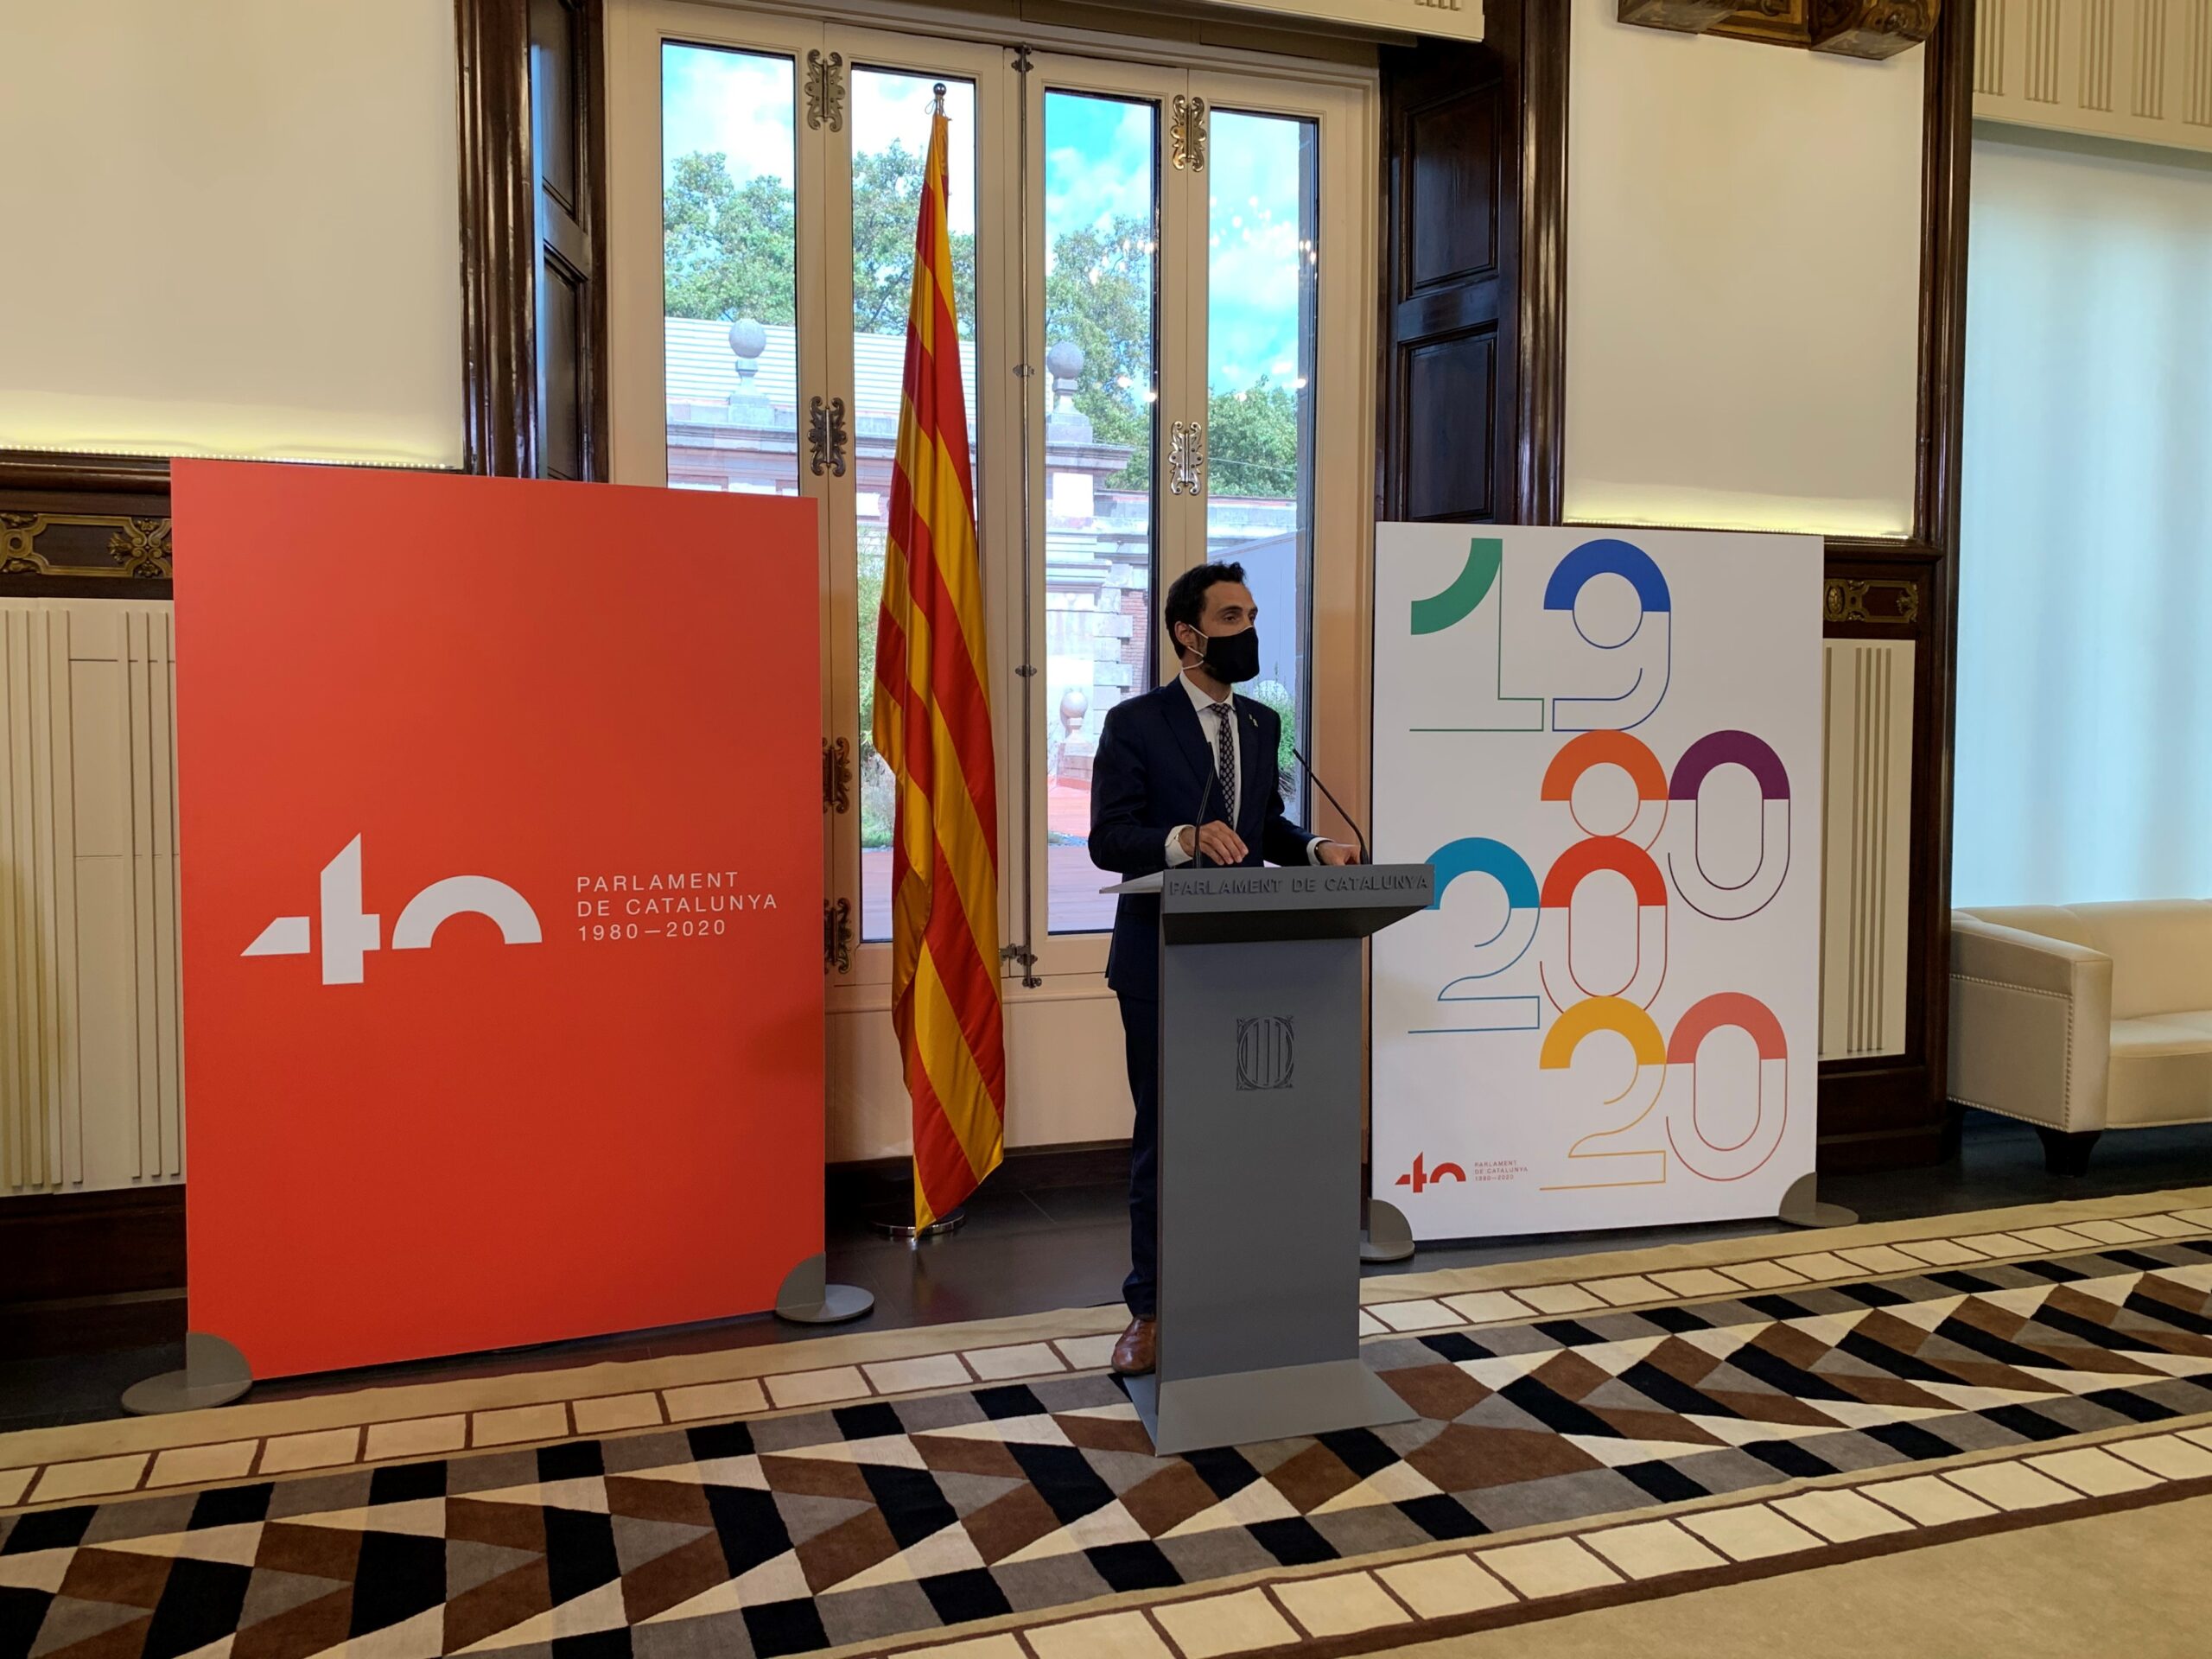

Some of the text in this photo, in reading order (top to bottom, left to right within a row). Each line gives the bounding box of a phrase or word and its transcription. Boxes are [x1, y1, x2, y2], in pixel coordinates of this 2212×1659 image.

[577, 871, 738, 893] PARLAMENT
[1169, 872, 1428, 896] PARLAMENT DE CATALUNYA
[577, 893, 777, 918] DE CATALUNYA
